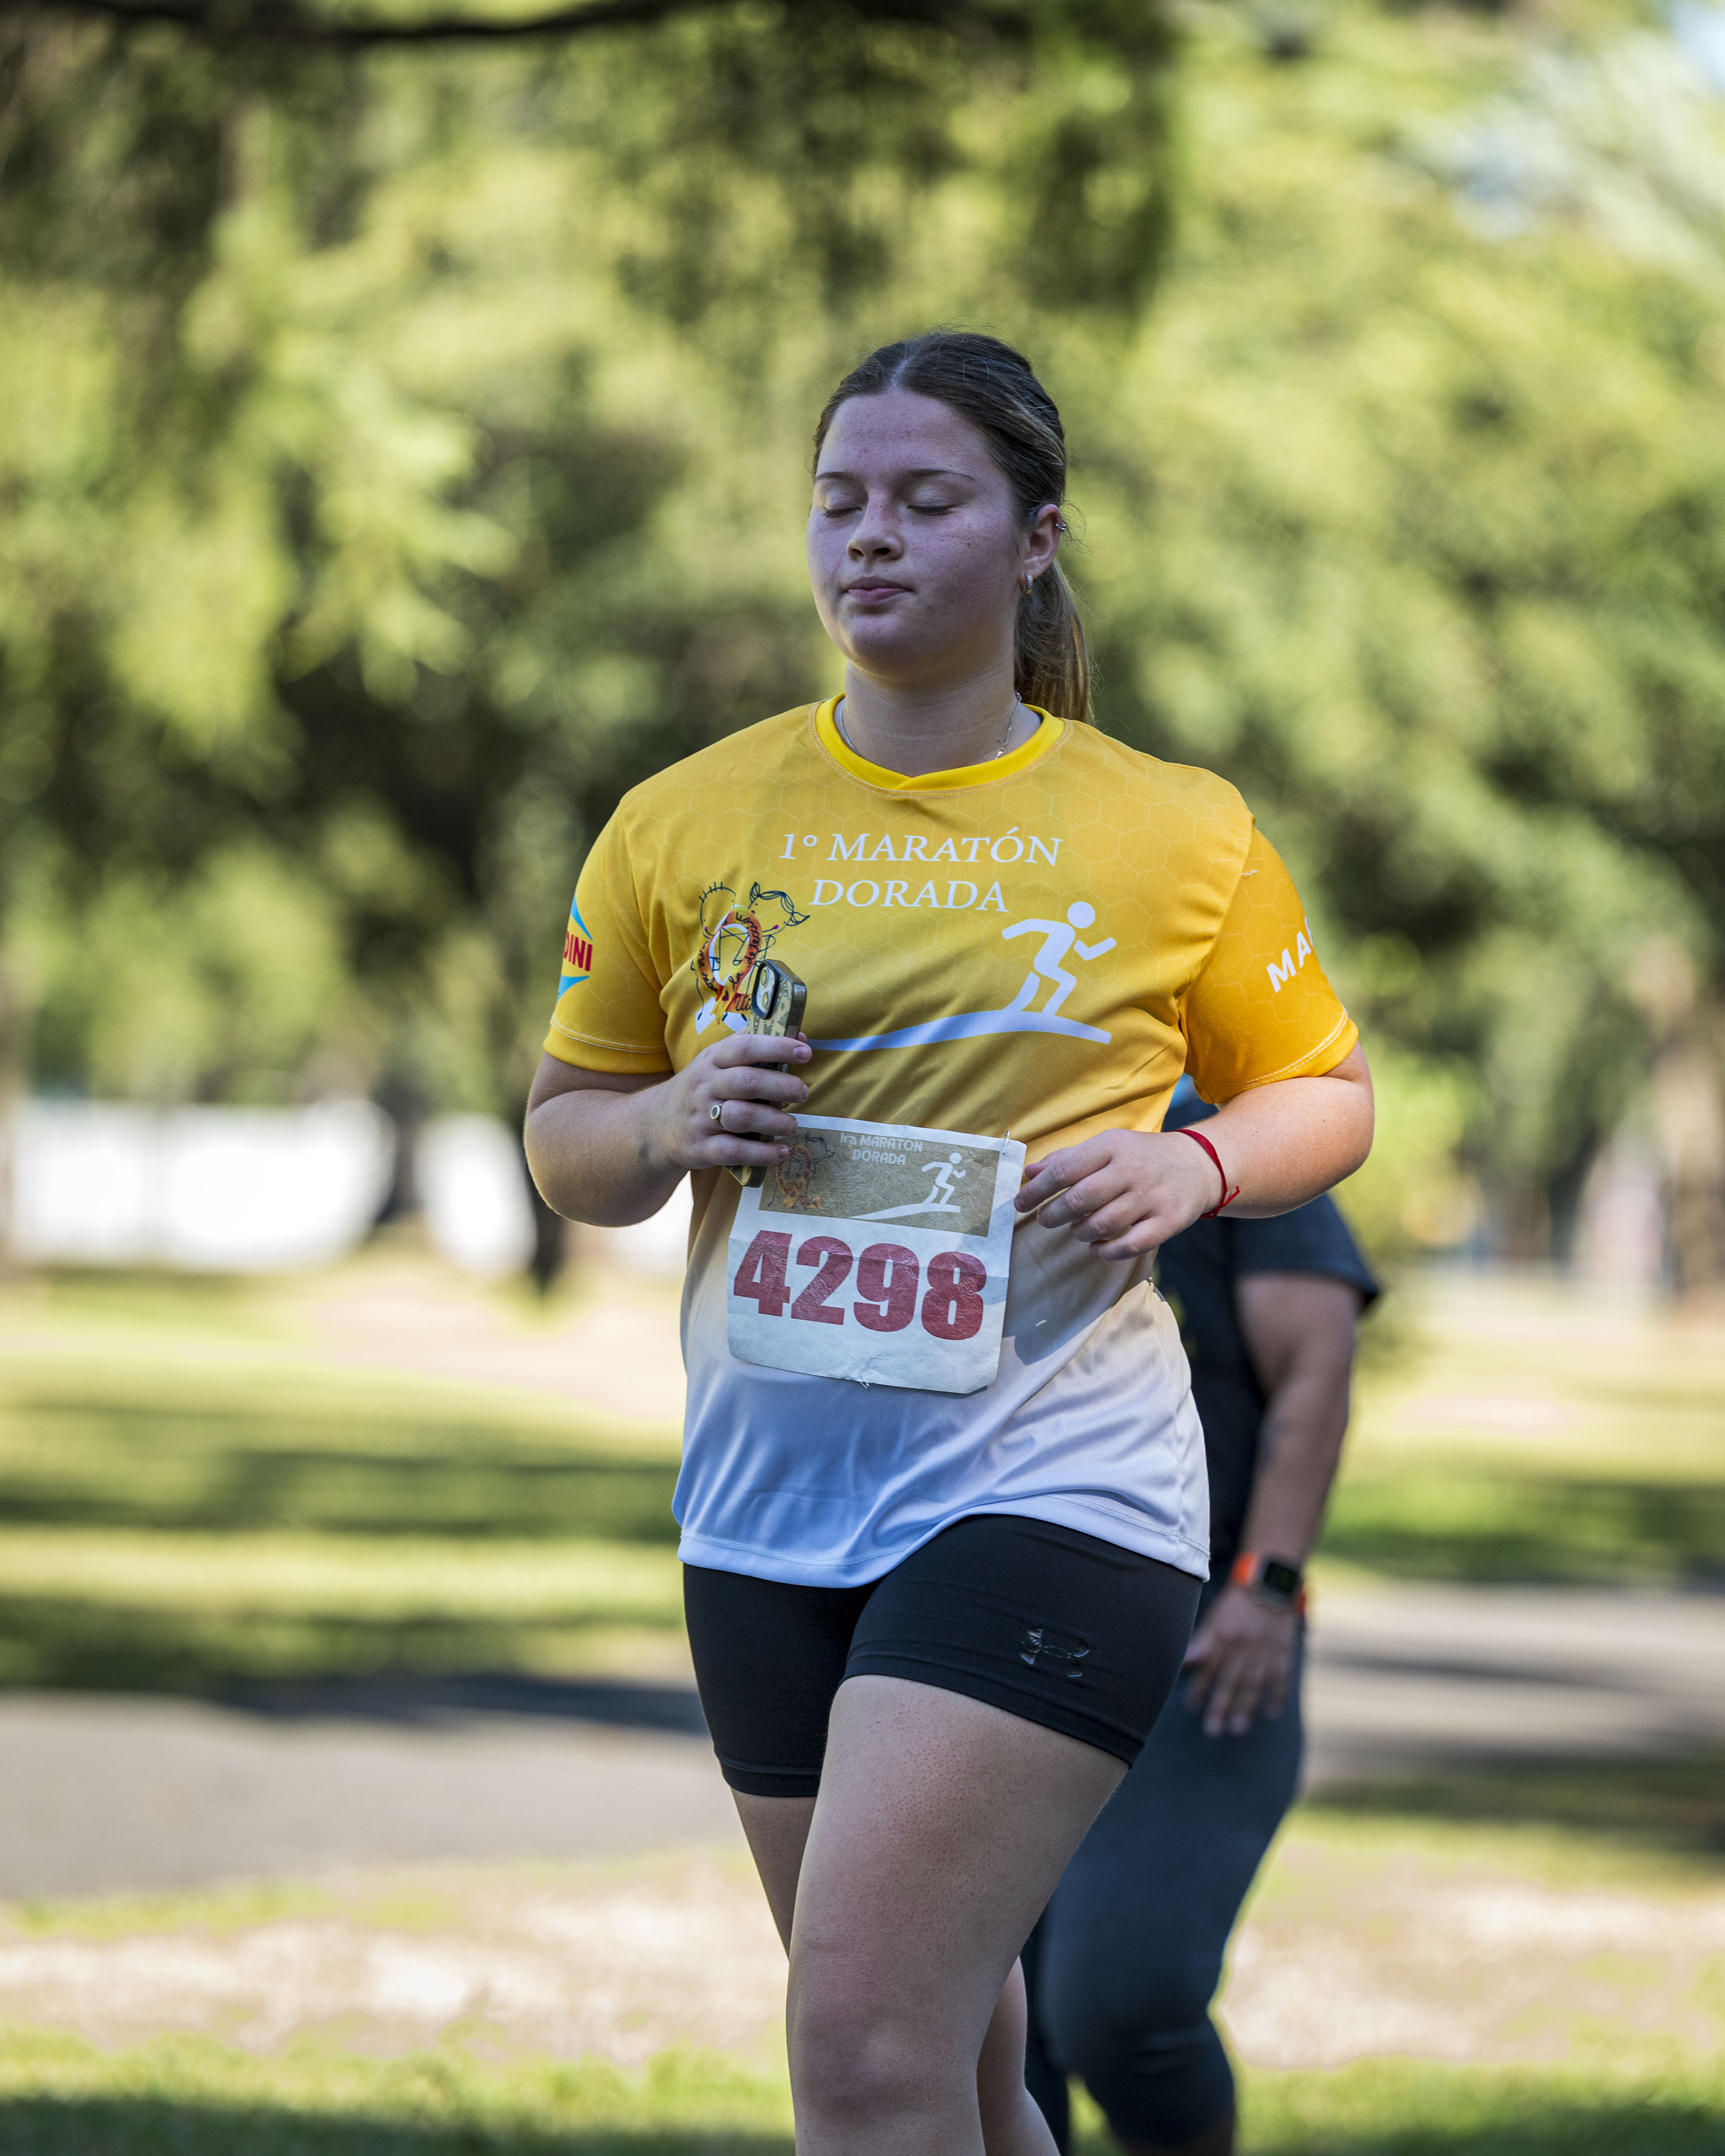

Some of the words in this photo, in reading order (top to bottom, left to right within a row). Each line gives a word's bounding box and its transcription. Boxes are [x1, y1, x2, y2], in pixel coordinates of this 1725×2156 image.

[826, 826, 1064, 866] MARATÓN
[809, 879, 1009, 912] DORADA
[1266, 916, 1313, 993] MA
[852, 1149, 906, 1166] DORADA
[860, 1135, 923, 1152] MARATON
[734, 1230, 987, 1341] 4298
